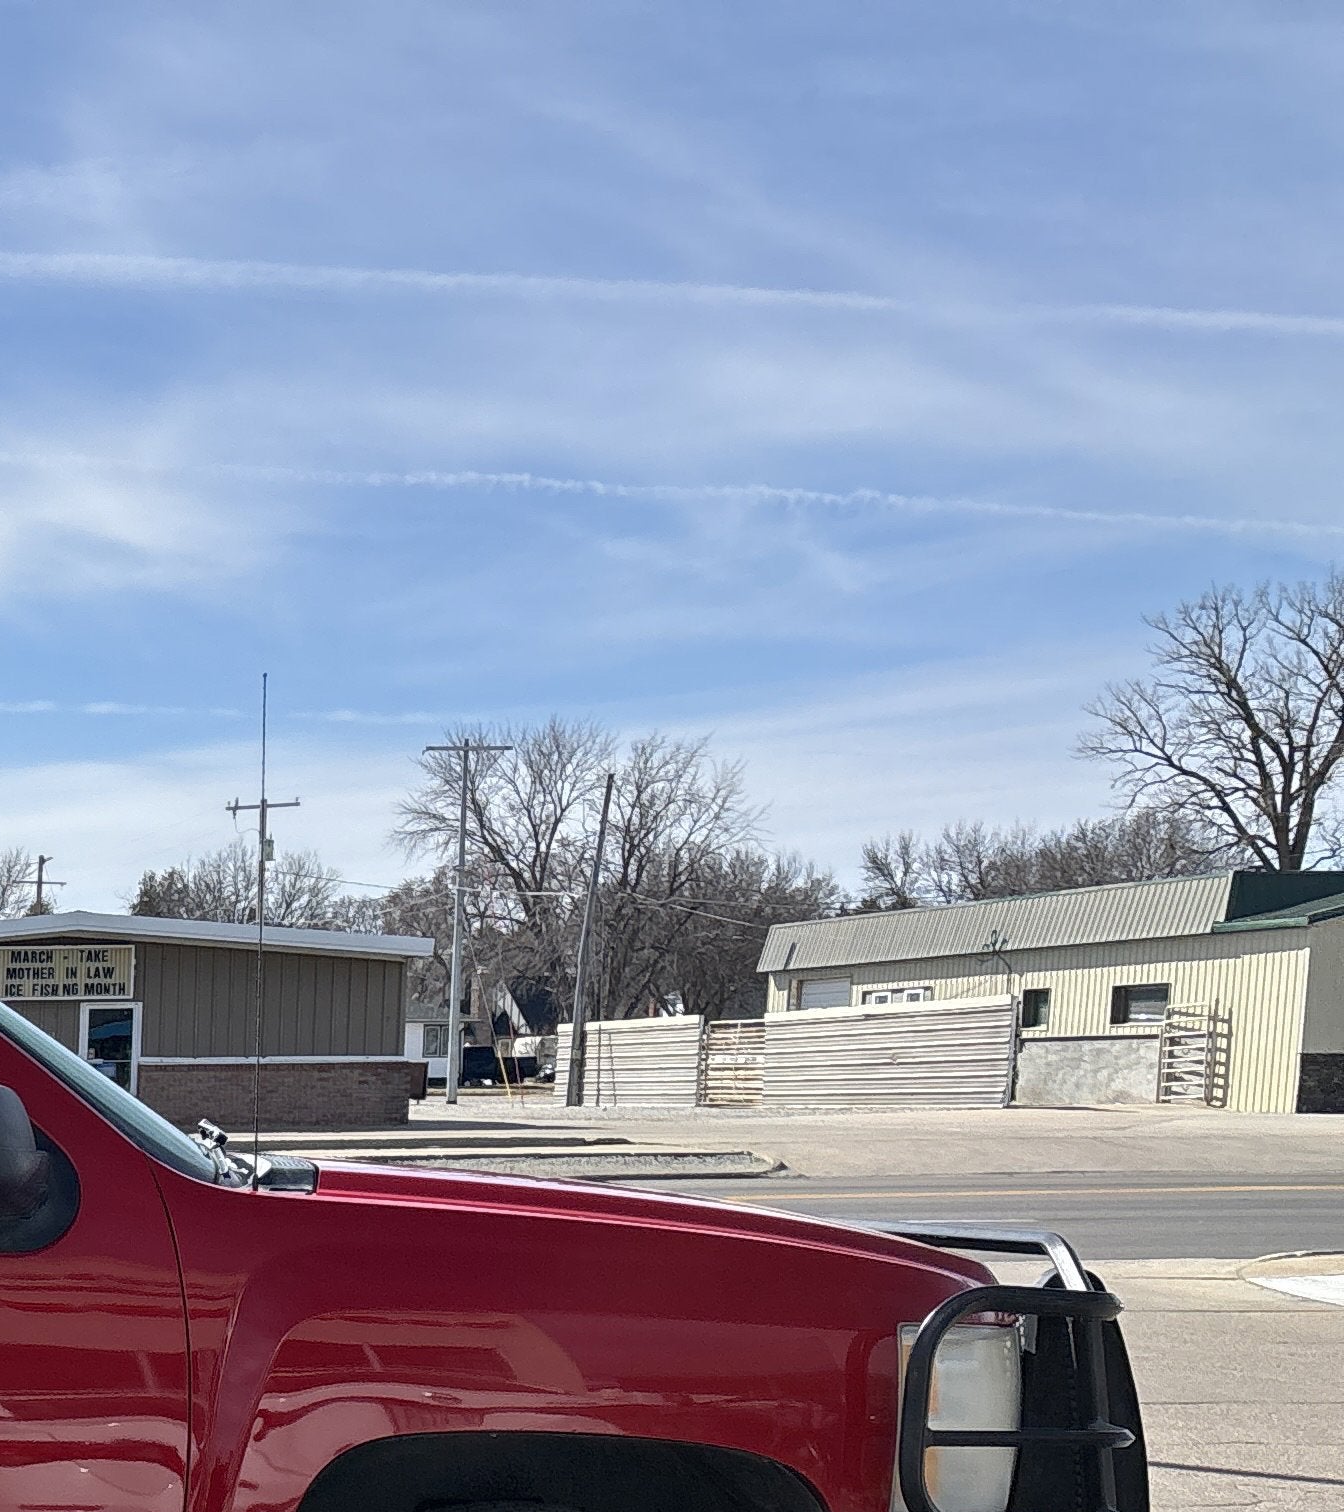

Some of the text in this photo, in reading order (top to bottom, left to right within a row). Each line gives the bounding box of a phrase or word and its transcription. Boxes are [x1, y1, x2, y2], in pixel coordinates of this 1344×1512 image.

[10, 950, 53, 964] MARCH
[79, 949, 109, 963] TAKE
[6, 966, 115, 980] MOTHER IN LAW
[4, 983, 24, 997] ICE
[84, 982, 126, 996] MONTH
